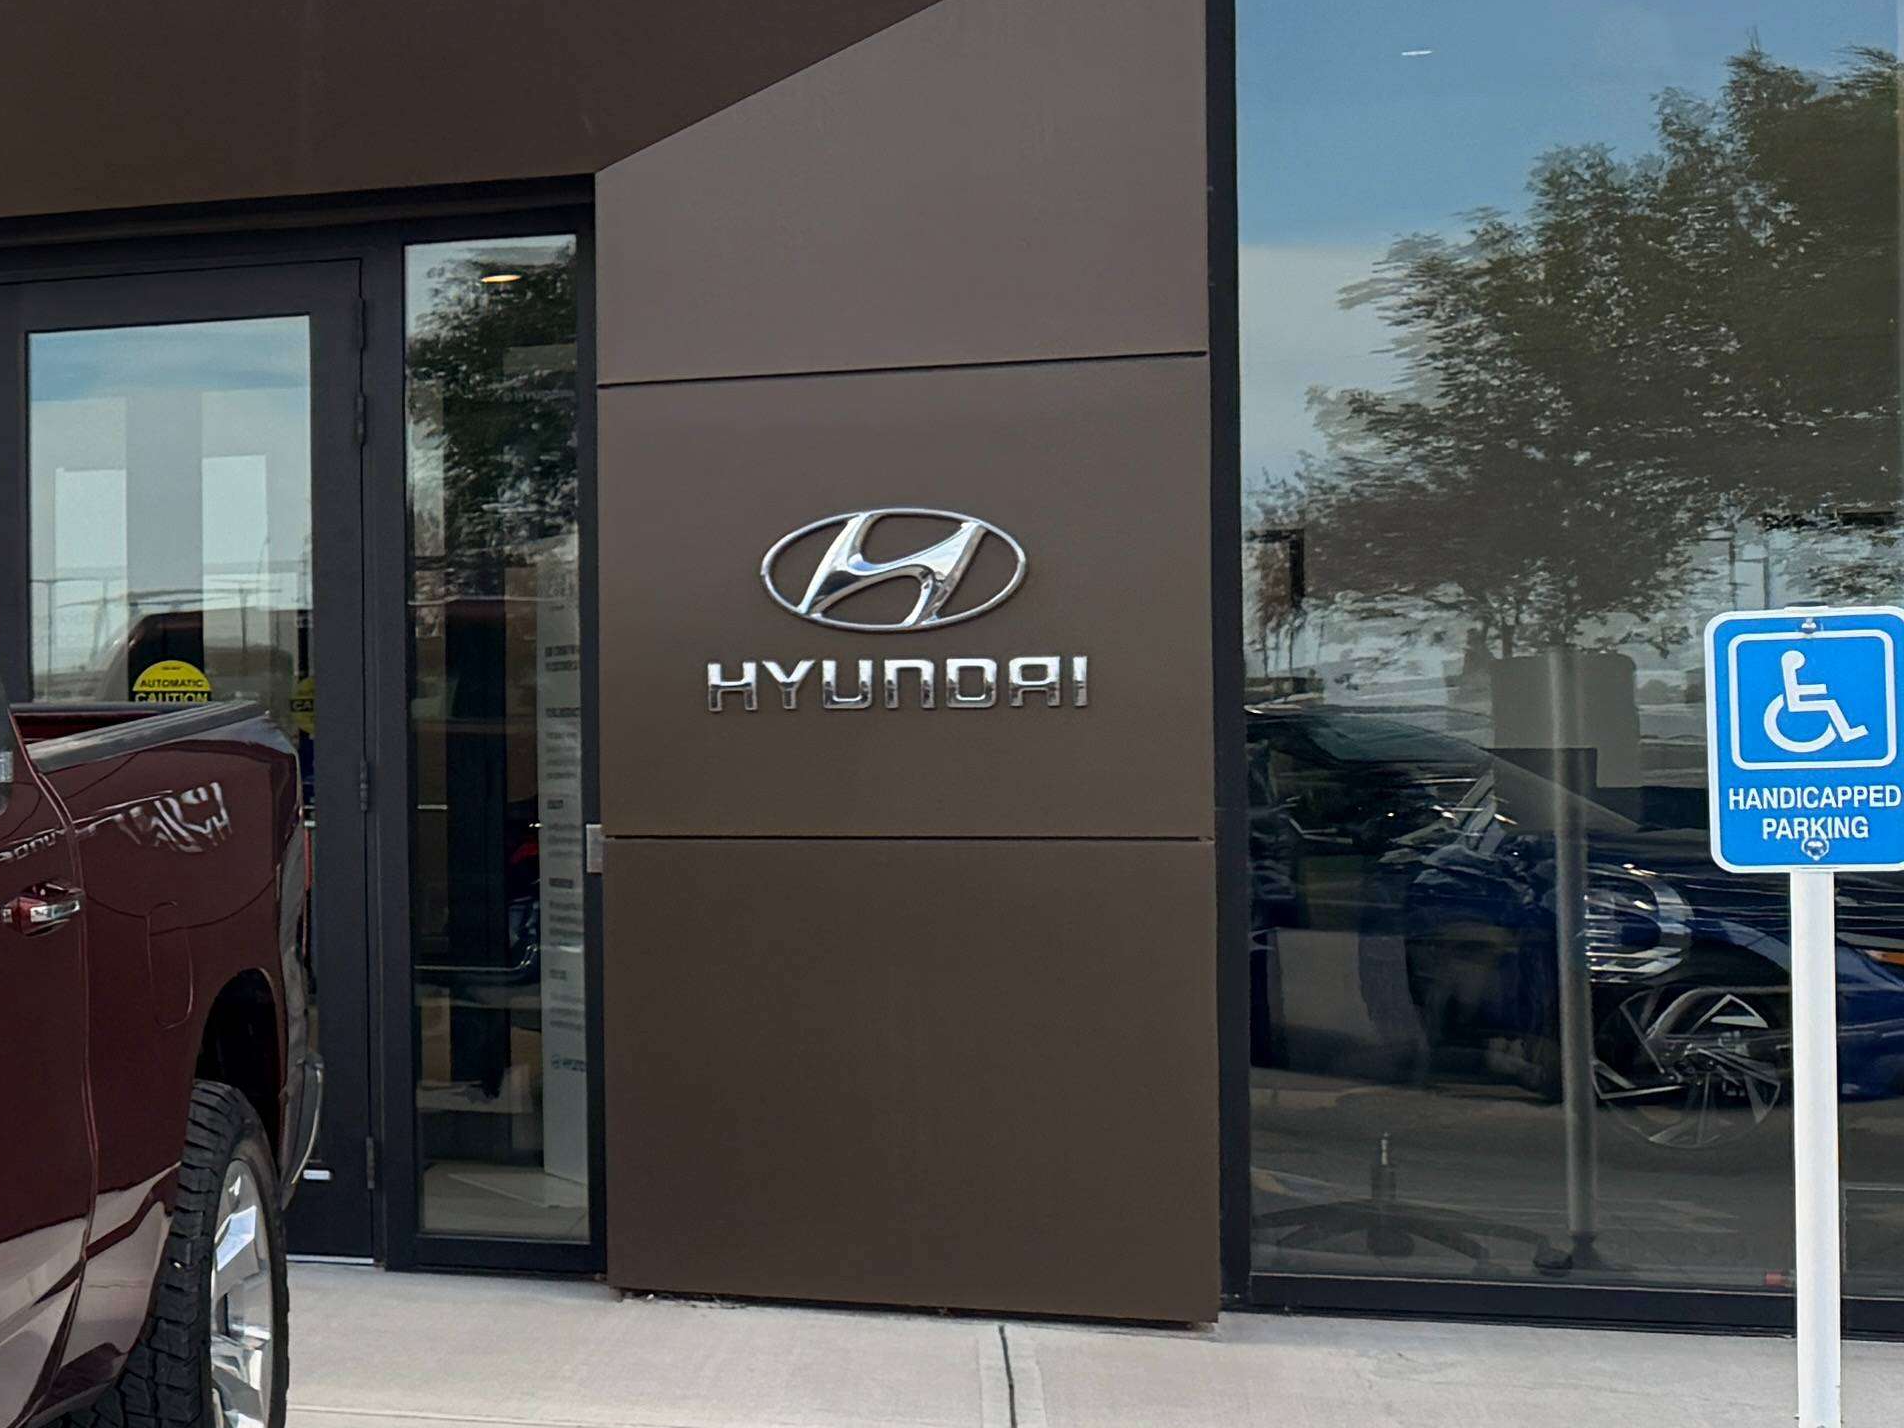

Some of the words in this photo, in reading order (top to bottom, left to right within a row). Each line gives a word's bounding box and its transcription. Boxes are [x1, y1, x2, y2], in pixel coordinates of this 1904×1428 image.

[140, 679, 204, 688] AUTOMATIC
[707, 655, 1088, 712] HYUNDAI
[135, 692, 208, 703] CAUTION
[1729, 785, 1902, 810] HANDICAPPED
[1762, 816, 1869, 840] PARKING
